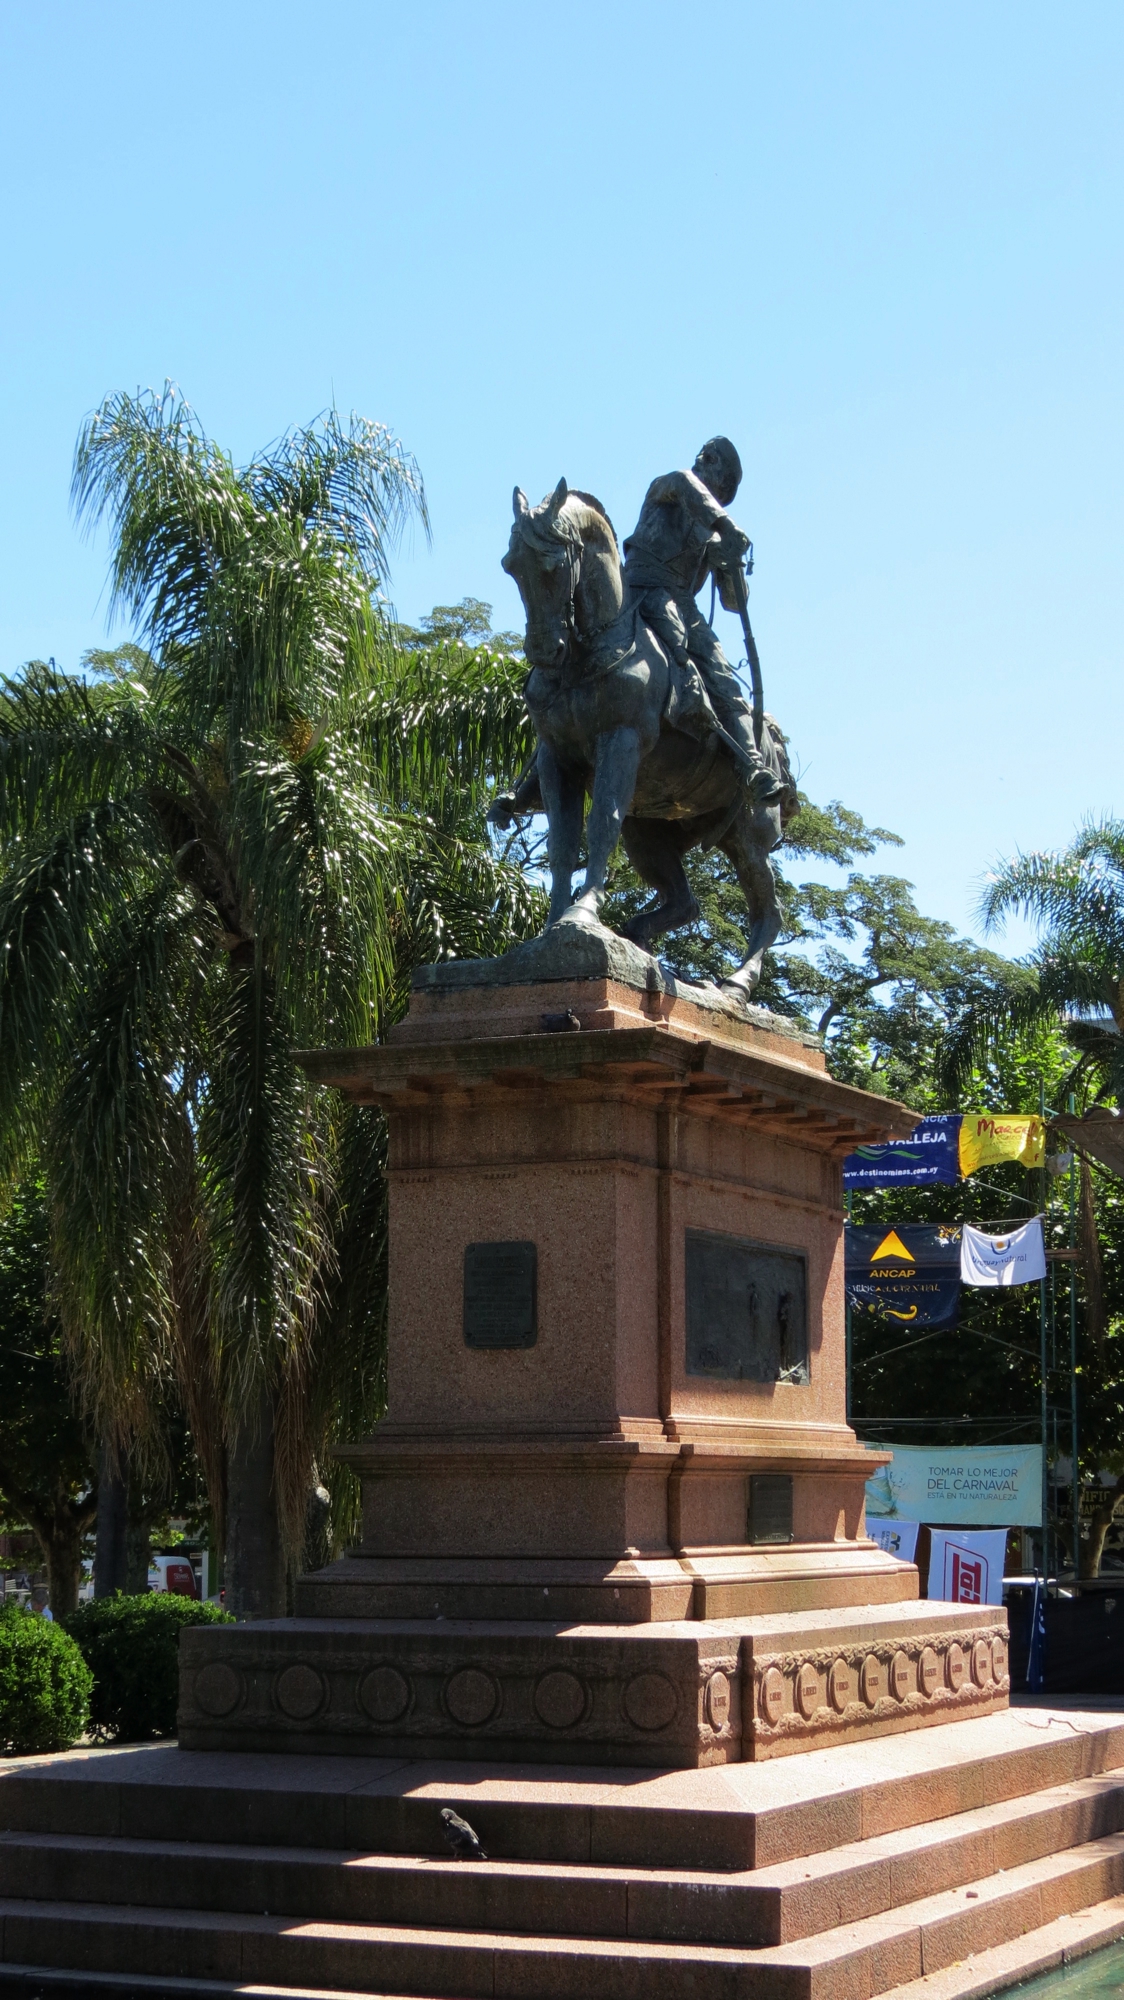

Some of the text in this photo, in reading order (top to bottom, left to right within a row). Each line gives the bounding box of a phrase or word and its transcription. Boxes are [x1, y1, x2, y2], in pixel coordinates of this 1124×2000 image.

[869, 1269, 916, 1278] ANCAP
[928, 1466, 1018, 1478] TOMAR LO MEJOR
[927, 1478, 1019, 1492] DEL CARNAVAL
[927, 1491, 945, 1499] ESTÁ
[969, 1492, 1018, 1501] NATURALEZA
